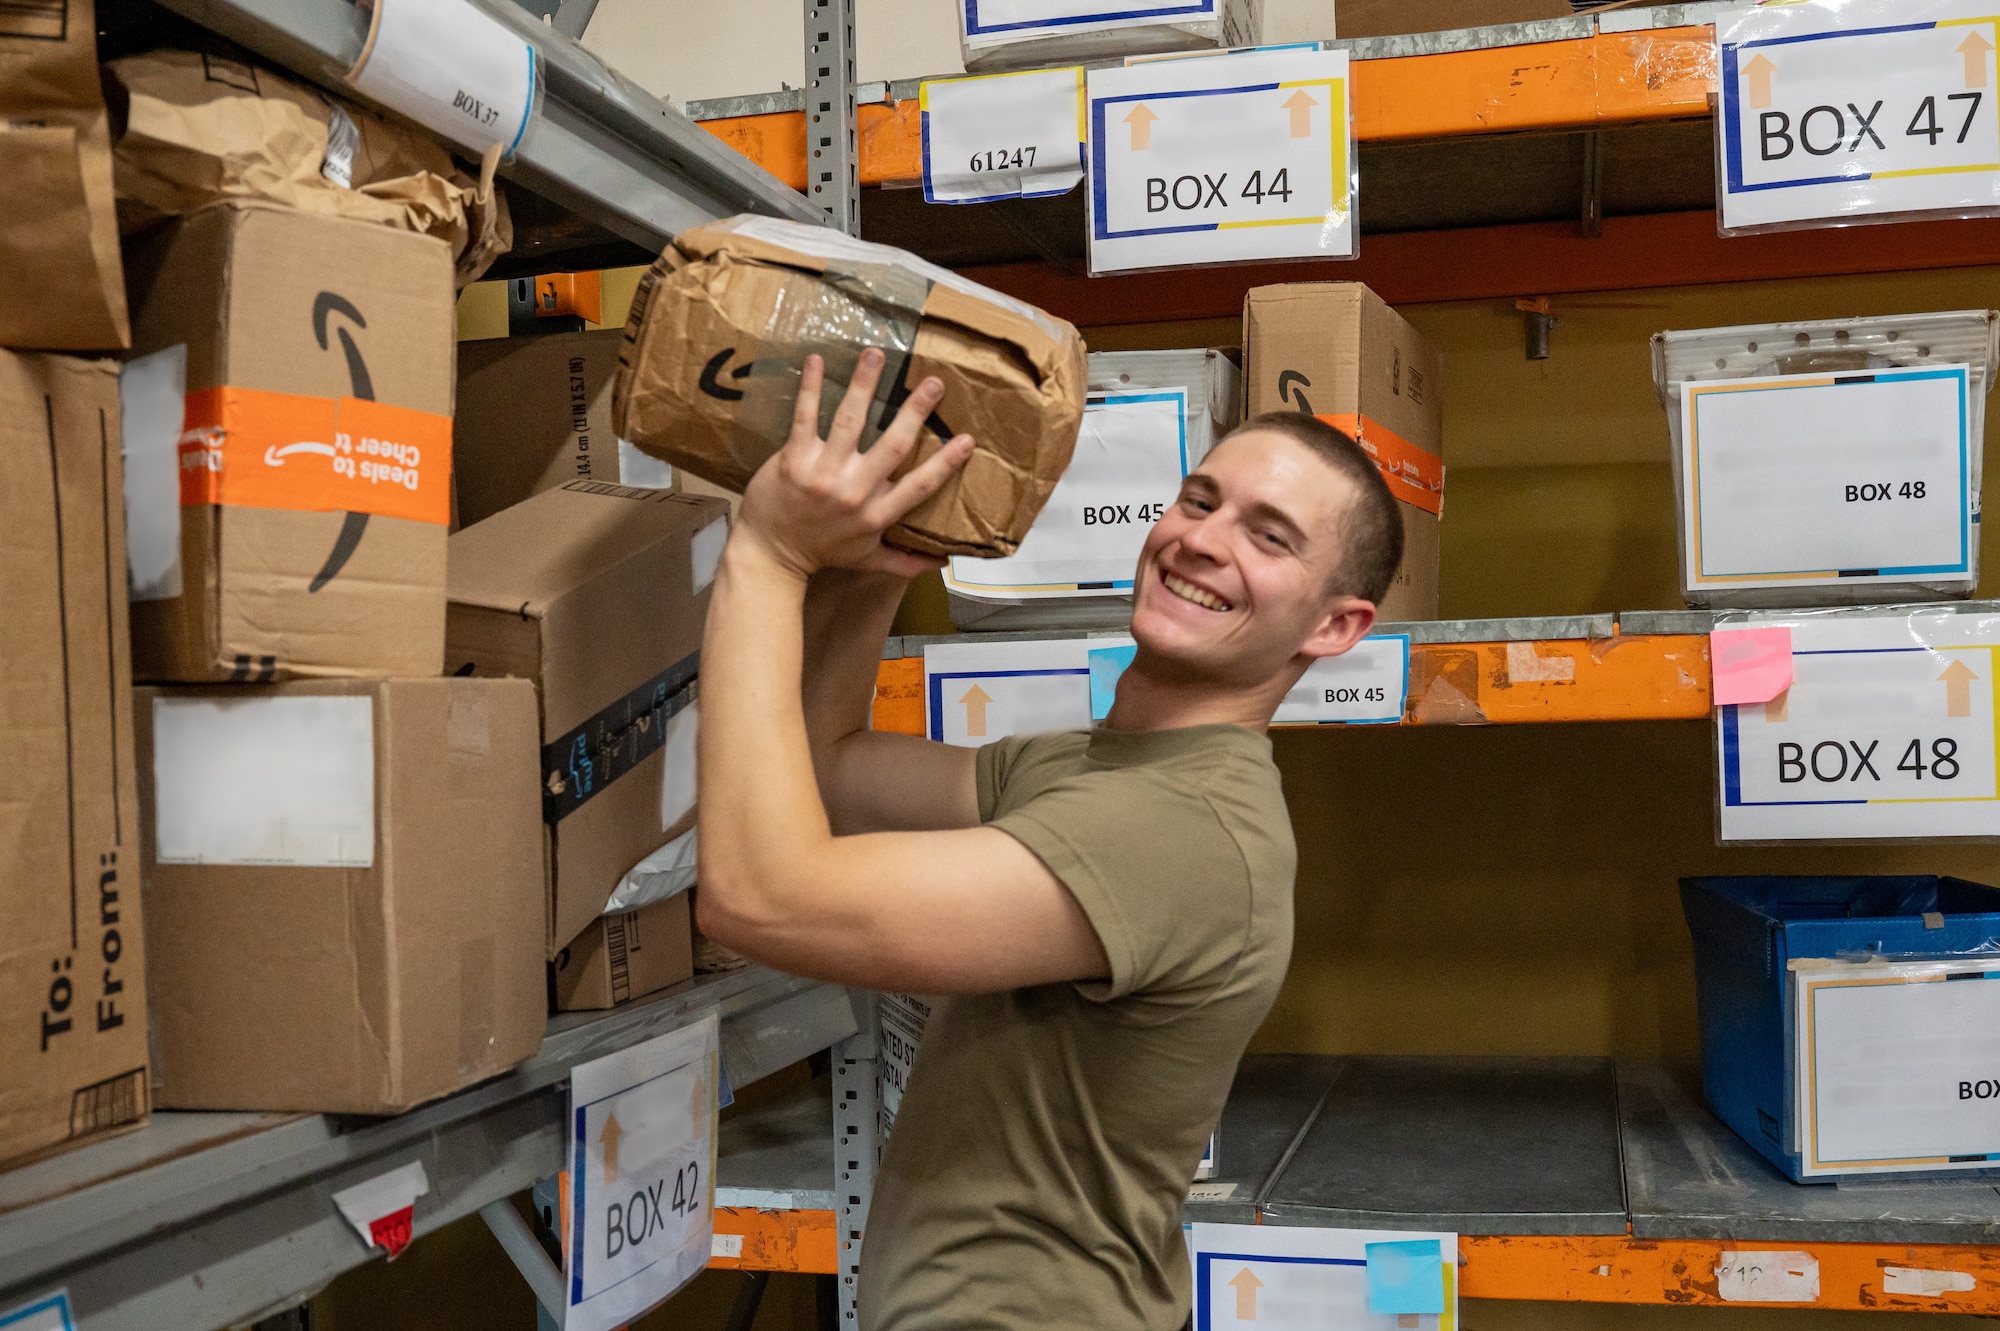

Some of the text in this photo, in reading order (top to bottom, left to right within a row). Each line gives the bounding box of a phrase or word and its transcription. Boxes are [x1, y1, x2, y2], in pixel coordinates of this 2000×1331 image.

[452, 89, 499, 127] BOX 37
[1759, 92, 1982, 161] BOX 47
[970, 146, 1037, 173] 61247
[1146, 168, 1293, 213] BOX 44
[568, 356, 586, 373] IN)
[569, 376, 585, 393] 5.7
[572, 403, 587, 416] IN
[573, 417, 591, 433] (11
[355, 436, 421, 468] Cheer
[578, 435, 589, 451] cm
[333, 455, 419, 491] Deals to
[576, 454, 592, 477] 14.4
[1845, 481, 1926, 502] BOX 48
[1083, 503, 1165, 525] BOX 45
[1325, 687, 1385, 703] BOX 45
[576, 732, 593, 793] prime
[1778, 737, 1960, 783] BOX 48
[97, 851, 124, 1033] From:
[40, 956, 72, 1052] To:
[1959, 1079, 2000, 1100] BOX
[607, 1160, 699, 1259] BOX 42
